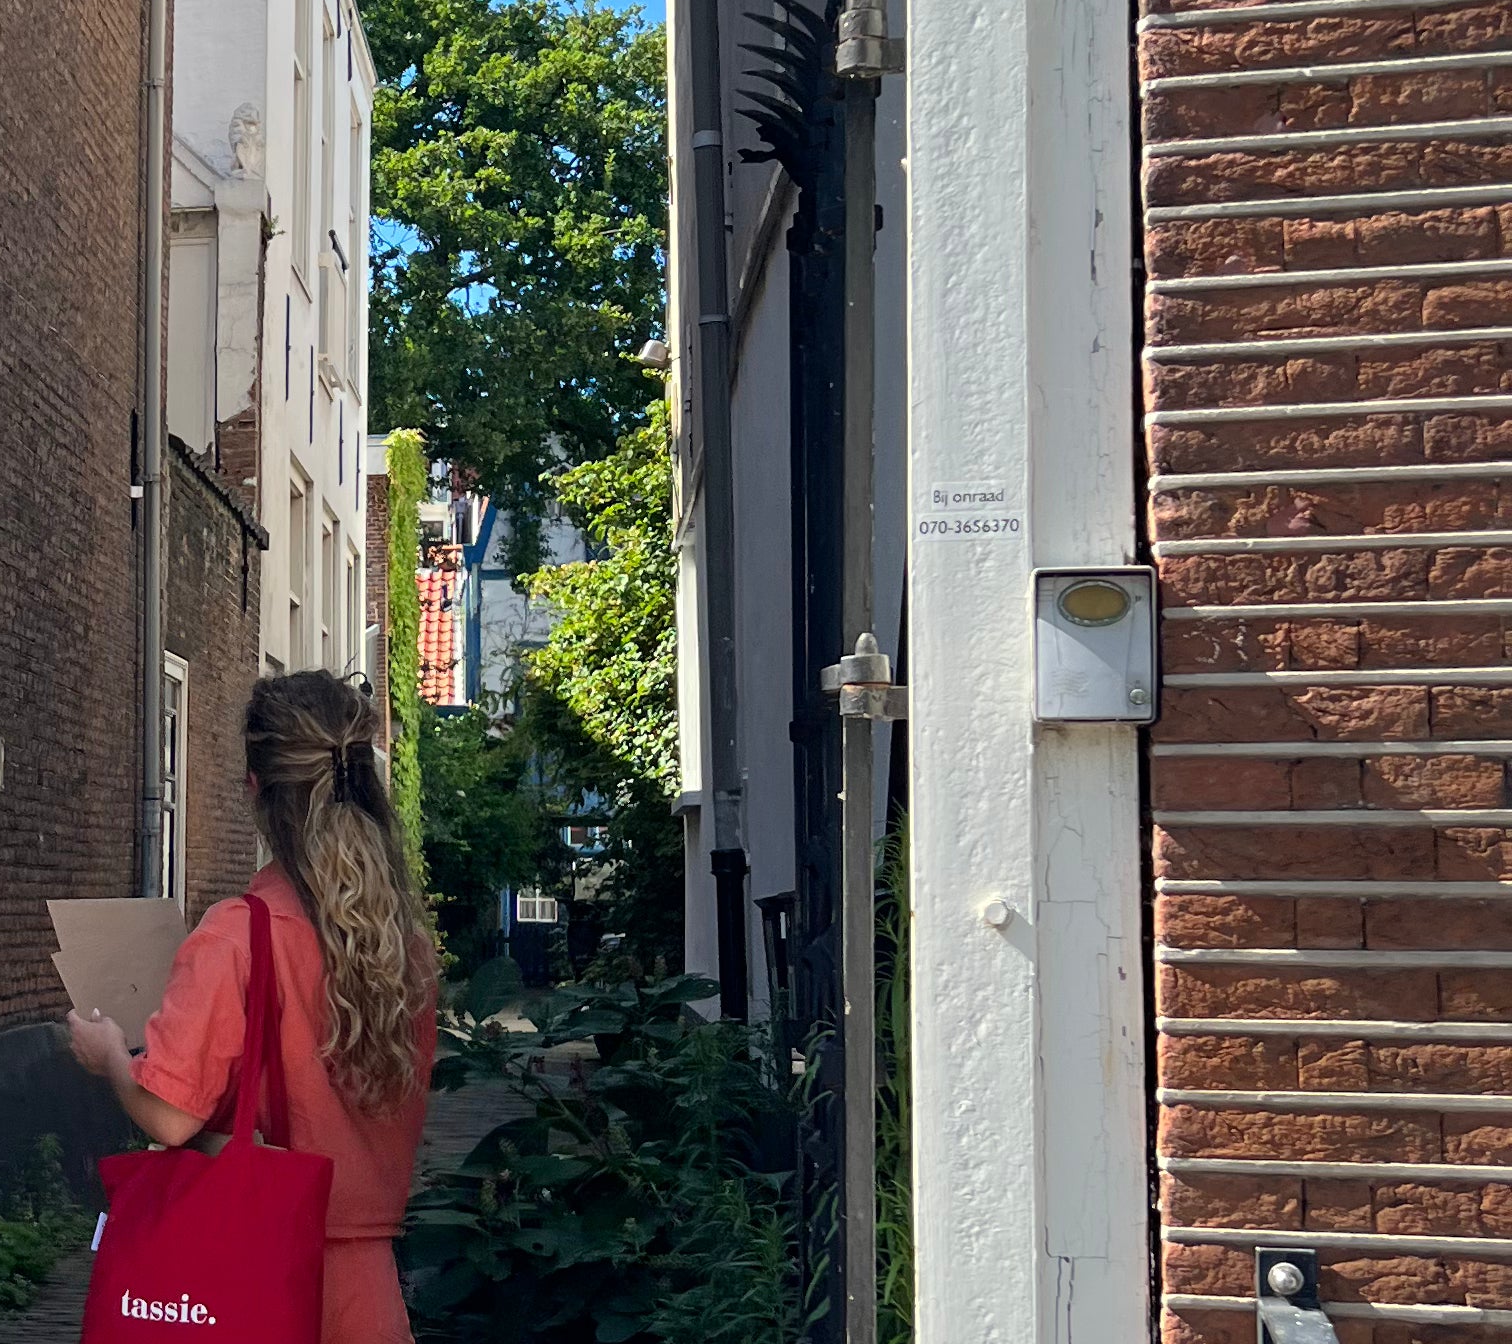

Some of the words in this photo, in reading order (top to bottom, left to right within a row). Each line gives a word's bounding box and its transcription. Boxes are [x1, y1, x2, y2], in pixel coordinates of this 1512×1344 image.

[933, 490, 948, 506] Bij
[953, 489, 1005, 503] onraad
[919, 518, 1020, 535] 070-3656370
[121, 1288, 217, 1325] tassie.
